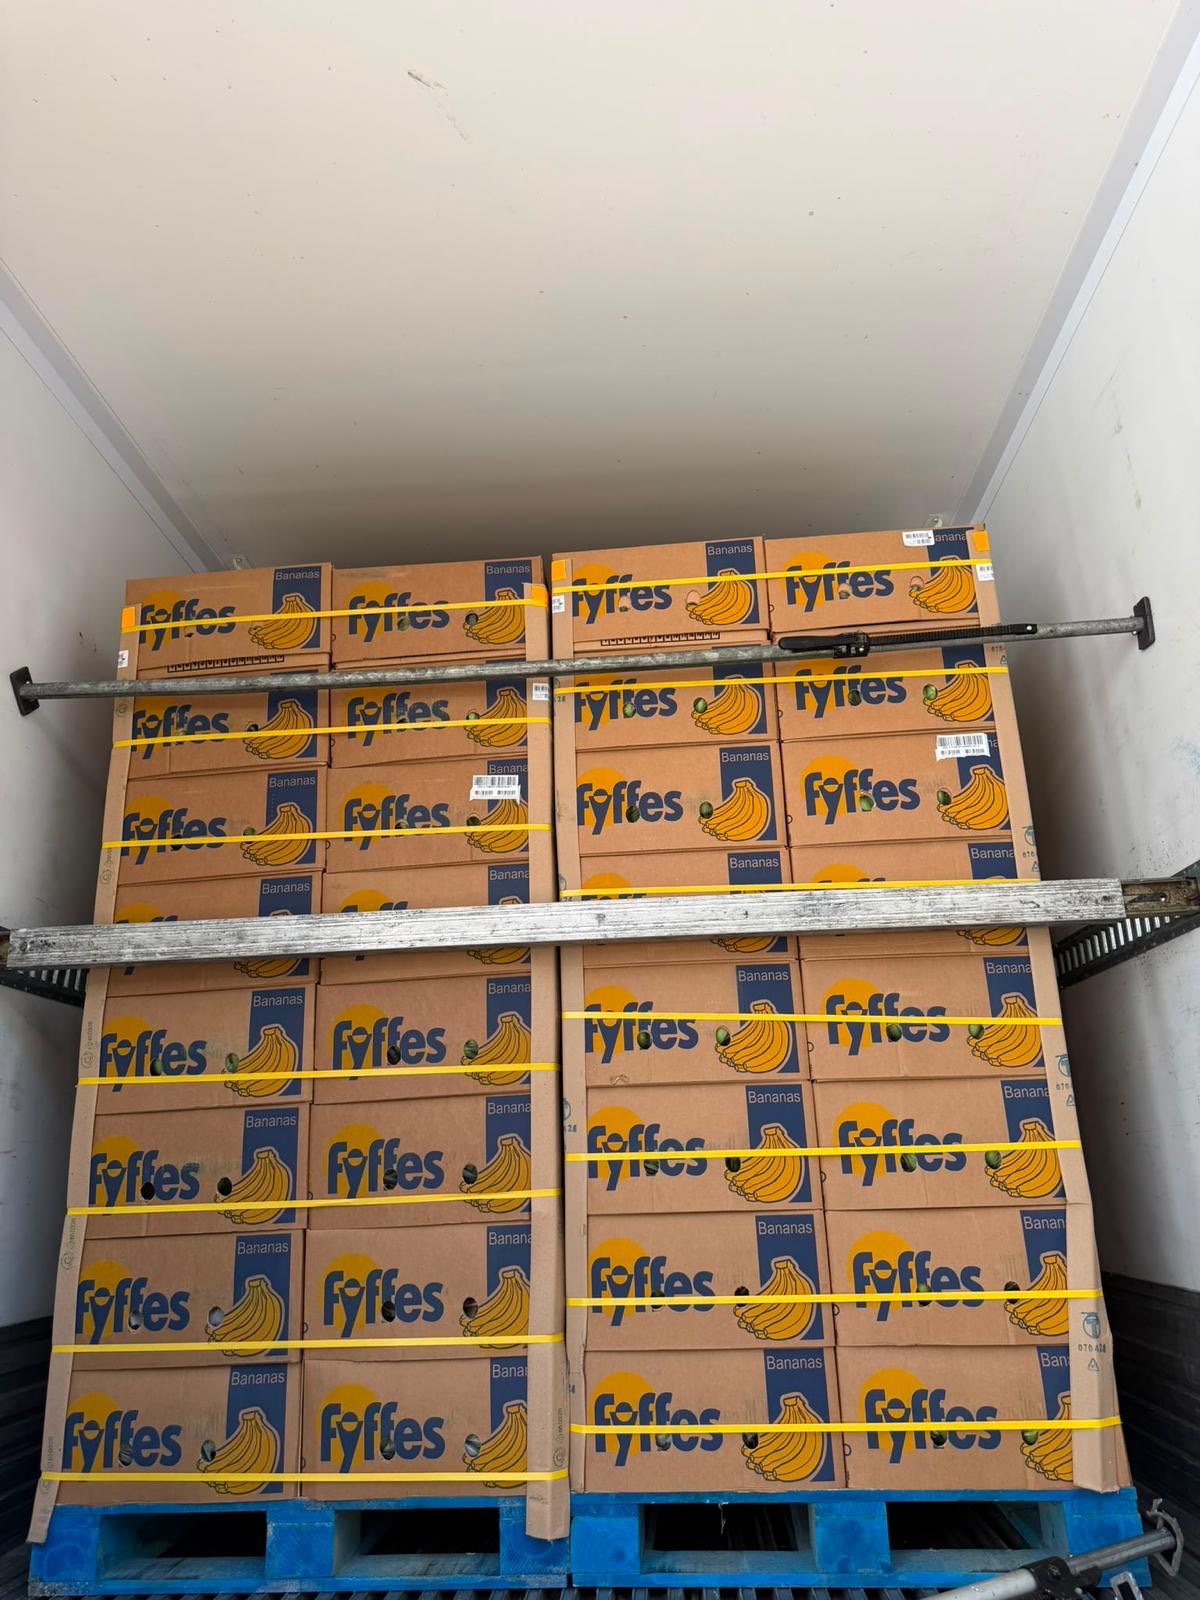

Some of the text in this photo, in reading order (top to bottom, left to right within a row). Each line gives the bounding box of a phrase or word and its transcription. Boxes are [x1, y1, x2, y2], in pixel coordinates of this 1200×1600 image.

[935, 533, 967, 543] anana
[707, 545, 753, 556] Bananas
[275, 570, 320, 581] Bananas
[486, 565, 531, 575] Bananas
[721, 751, 769, 763] Bananas
[488, 763, 528, 775] Banana
[268, 776, 316, 788] Bananas
[970, 847, 1014, 859] Banana
[729, 857, 780, 869] Bananas
[489, 869, 530, 881] Banana
[261, 882, 311, 894] Bananas
[986, 962, 1031, 974] Banana
[738, 970, 789, 982] Bananas
[488, 982, 531, 995] Banana
[252, 994, 303, 1007] Bananas
[748, 1091, 801, 1104] Bananas
[1004, 1086, 1050, 1099] Banana
[487, 1102, 531, 1115] Banana
[246, 1115, 297, 1128] Bananas
[758, 1221, 813, 1235] Bananas
[1024, 1216, 1065, 1230] Banan
[488, 1231, 532, 1246] Banana
[237, 1241, 289, 1255] Bananas
[767, 1355, 823, 1370] Bananas
[492, 1363, 528, 1378] Bana
[231, 1371, 285, 1386] Bananas
